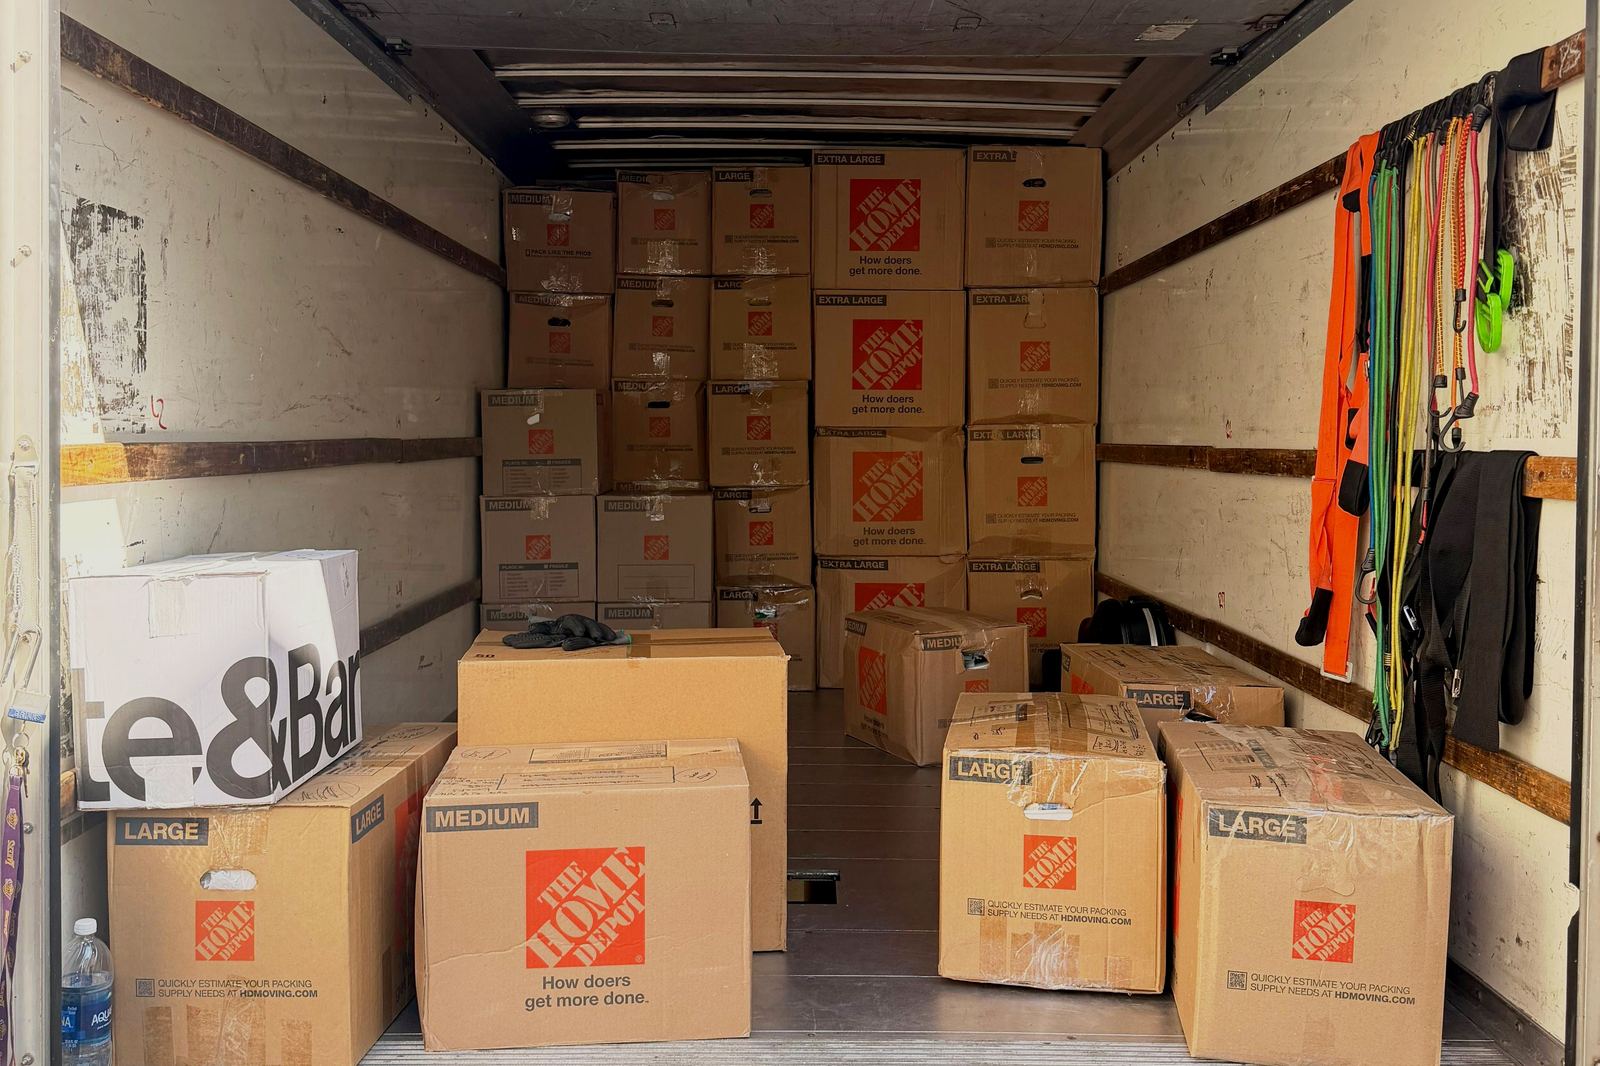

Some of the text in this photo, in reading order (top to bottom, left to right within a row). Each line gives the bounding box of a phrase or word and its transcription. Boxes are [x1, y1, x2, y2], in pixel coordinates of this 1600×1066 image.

[817, 155, 882, 164] EXTRA LARGE
[976, 152, 1008, 161] EXTRA
[622, 174, 648, 183] MEDI
[719, 172, 751, 180] LARGE
[856, 186, 887, 215] THE
[849, 179, 920, 251] HOME
[876, 205, 920, 251] DEPOT
[859, 256, 912, 265] How doers
[849, 267, 865, 276] get
[819, 296, 884, 305] EXTRA LARGE
[976, 296, 1029, 304] EXTRA LAR
[859, 326, 889, 354] THE
[853, 320, 923, 390] HOME
[879, 346, 922, 390] DEPOT
[618, 382, 650, 391] MEDIU
[492, 395, 535, 405] MEDIUM
[862, 395, 914, 404] How doers
[852, 406, 868, 415] get
[974, 431, 1006, 440] EXT
[718, 490, 749, 499] LARGE
[853, 452, 923, 521] HOME
[863, 527, 915, 536] How doers
[853, 538, 869, 547] get
[822, 560, 885, 569] EXTRA LARGE
[972, 562, 1037, 571] EXTRA LARGE
[608, 609, 651, 618] MEDIUM
[927, 637, 962, 649] MEDIU
[1132, 691, 1185, 706] LARGE
[957, 760, 1023, 781] LARGE
[355, 801, 382, 836] LARGE
[435, 807, 530, 828] MEDIUM
[1218, 813, 1297, 838] LARGE
[125, 823, 199, 840] LARGE
[1028, 840, 1052, 862] THE
[1023, 836, 1077, 888] HOME
[1043, 856, 1077, 889] DEPOT
[537, 860, 588, 909] THE
[525, 846, 646, 968] HOME
[987, 899, 1127, 917] QUICKLY ESTIMATE YOUR PACKING
[200, 906, 226, 931] THE
[987, 908, 1132, 926] SUPPLY NEEDS AT HDMOVING.COM
[1299, 908, 1326, 931] THE
[194, 901, 255, 960] HOME
[572, 889, 646, 967] DEPOT
[1293, 904, 1356, 960] HOME
[218, 922, 255, 961] DEPOT
[1315, 925, 1355, 961] DEPOT
[158, 979, 312, 989] QUICKLY ESTIMATE YOUR PACKING
[542, 974, 631, 990] How doers
[1250, 973, 1411, 996] QUICKLY ESTIMATE YOUR PACKING
[158, 990, 318, 998] SUPPLY NEEDS AT HDMOVING.COM
[525, 994, 552, 1012] get
[556, 994, 599, 1007] more
[1250, 982, 1416, 1006] SUPPLY NEEDS AT HDMOVING.COM
